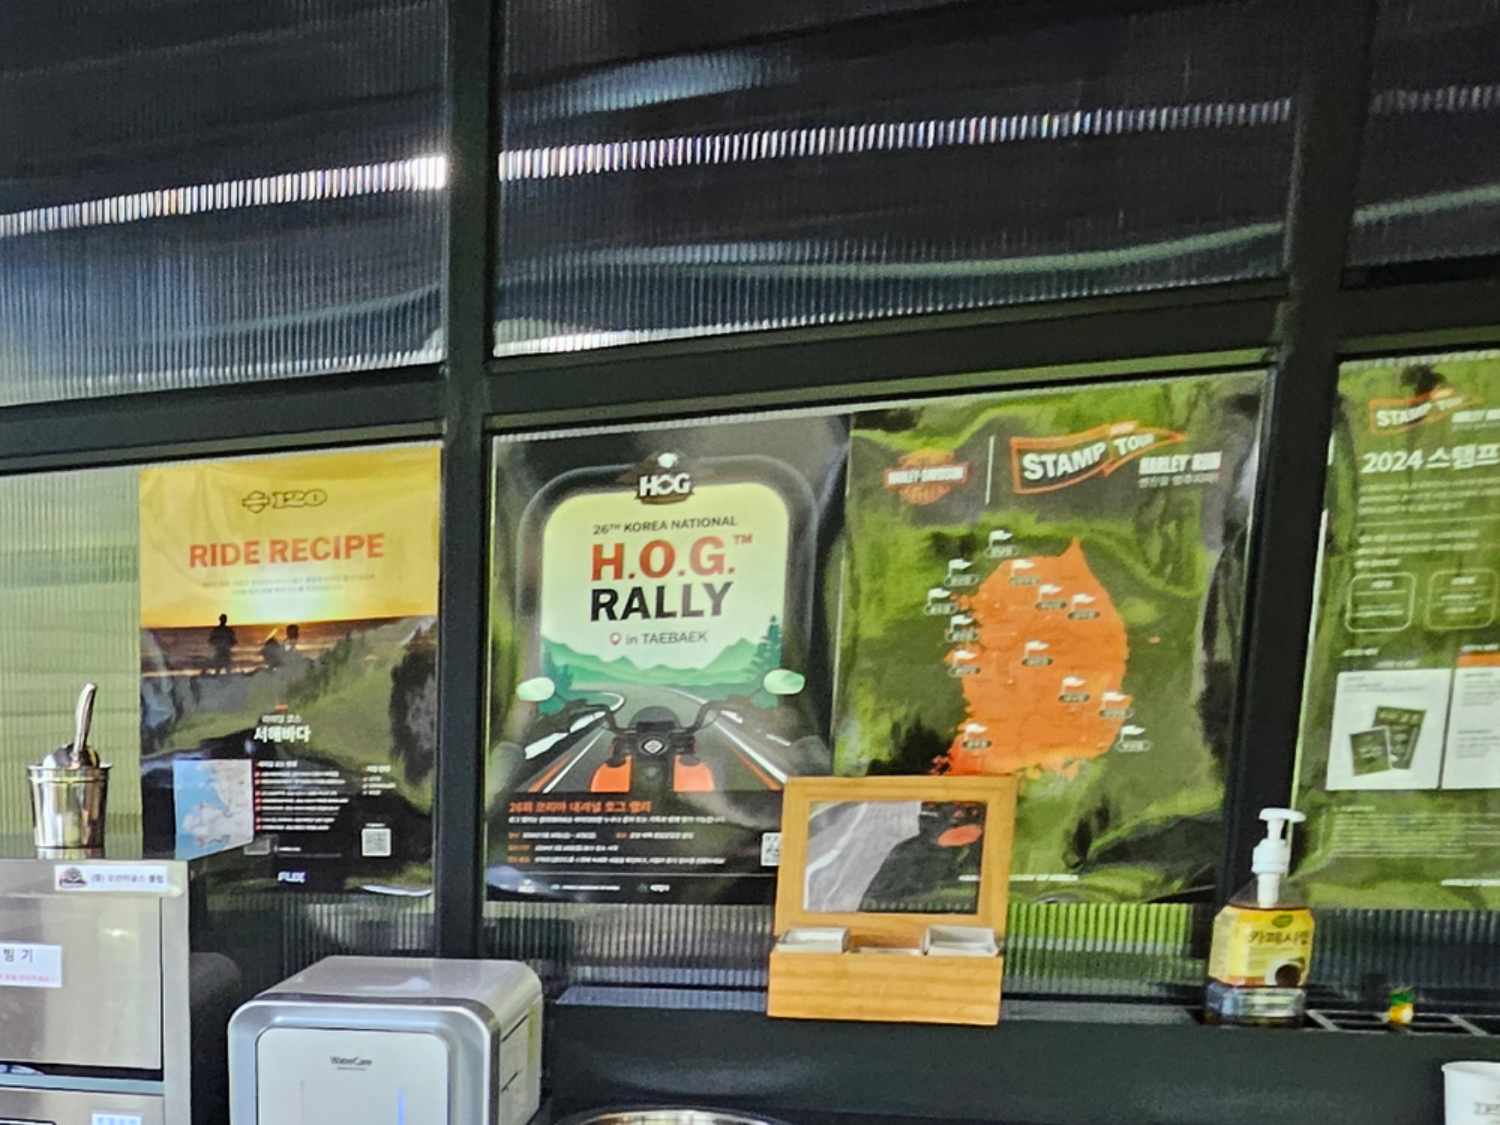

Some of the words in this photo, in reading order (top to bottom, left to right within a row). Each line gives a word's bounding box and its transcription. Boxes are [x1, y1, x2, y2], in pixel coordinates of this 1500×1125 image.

[1022, 441, 1106, 481] STAMP
[1113, 433, 1155, 456] TOUR
[1361, 449, 1423, 474] 2024
[1425, 443, 1500, 471] 스탬프
[639, 472, 692, 497] HOG
[623, 520, 668, 533] KOREA
[670, 515, 738, 530] NATIONAL
[189, 540, 261, 569] RIDE
[269, 532, 386, 564] RECIPE
[590, 581, 734, 622] RALLY
[626, 634, 638, 645] in
[642, 630, 708, 645] TAEBAEK
[253, 724, 312, 743] 서해바다
[330, 1055, 373, 1068] WaterCare
